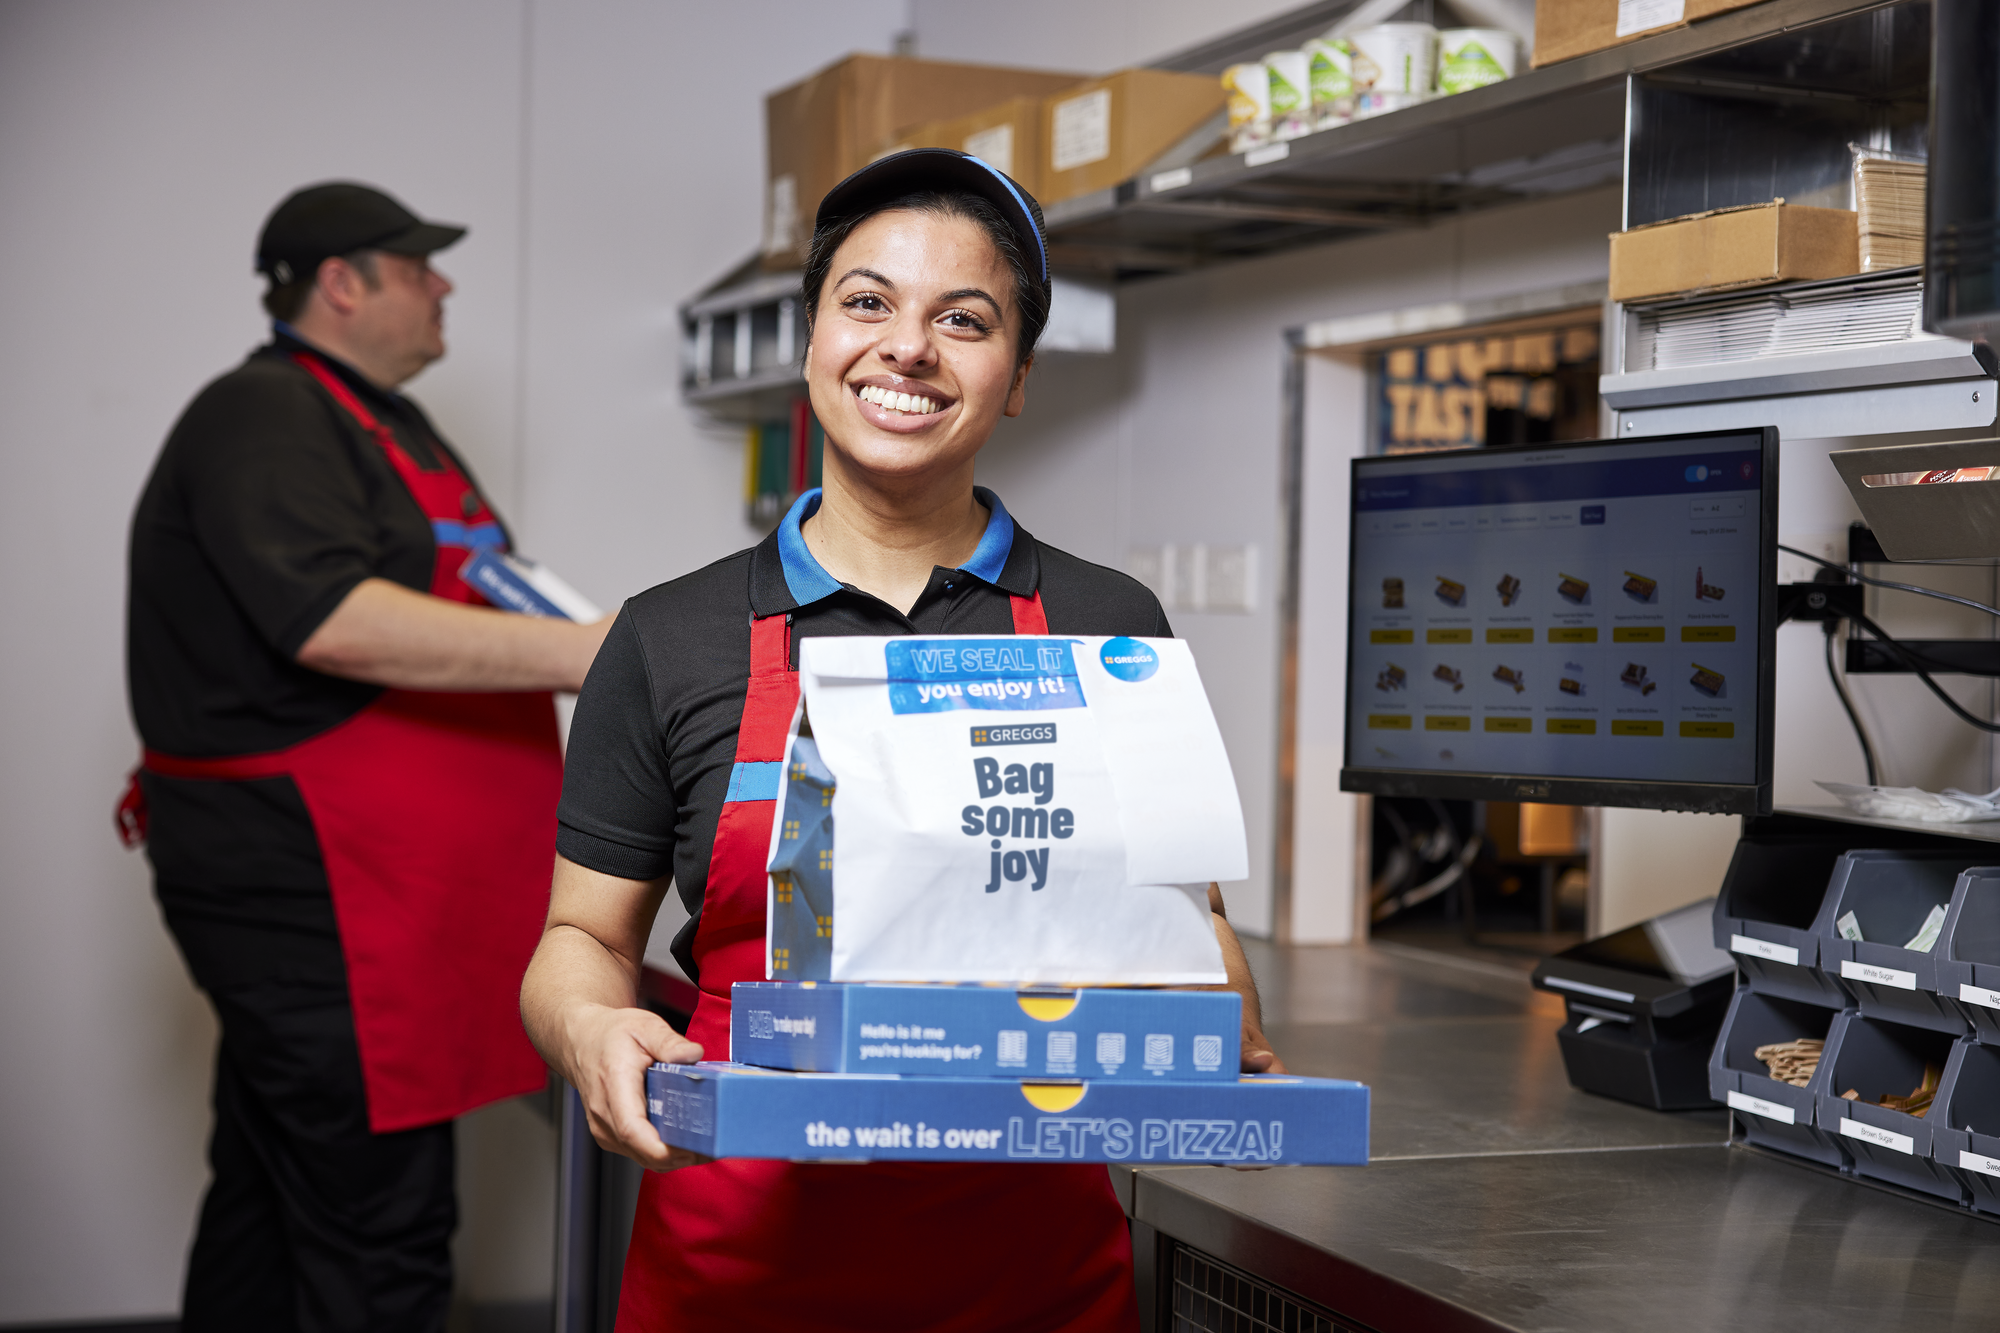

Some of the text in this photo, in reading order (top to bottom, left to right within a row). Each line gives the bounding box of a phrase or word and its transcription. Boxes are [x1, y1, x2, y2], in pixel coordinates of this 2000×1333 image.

[911, 647, 1063, 674] WE SEAL IT
[1114, 655, 1153, 664] GREGGS
[917, 676, 1067, 704] you enjoy it!
[990, 726, 1053, 742] GREGGS
[973, 756, 1054, 805] Bag
[961, 805, 1075, 839] some
[985, 838, 1050, 893] joy
[1863, 968, 1895, 983] White Sugar
[860, 1023, 946, 1040] Hello is it me
[859, 1042, 983, 1062] you're looking for?
[805, 1116, 1284, 1161] the wait is over LET'S PIZZA!
[1861, 1127, 1895, 1145] Brown Sugar
